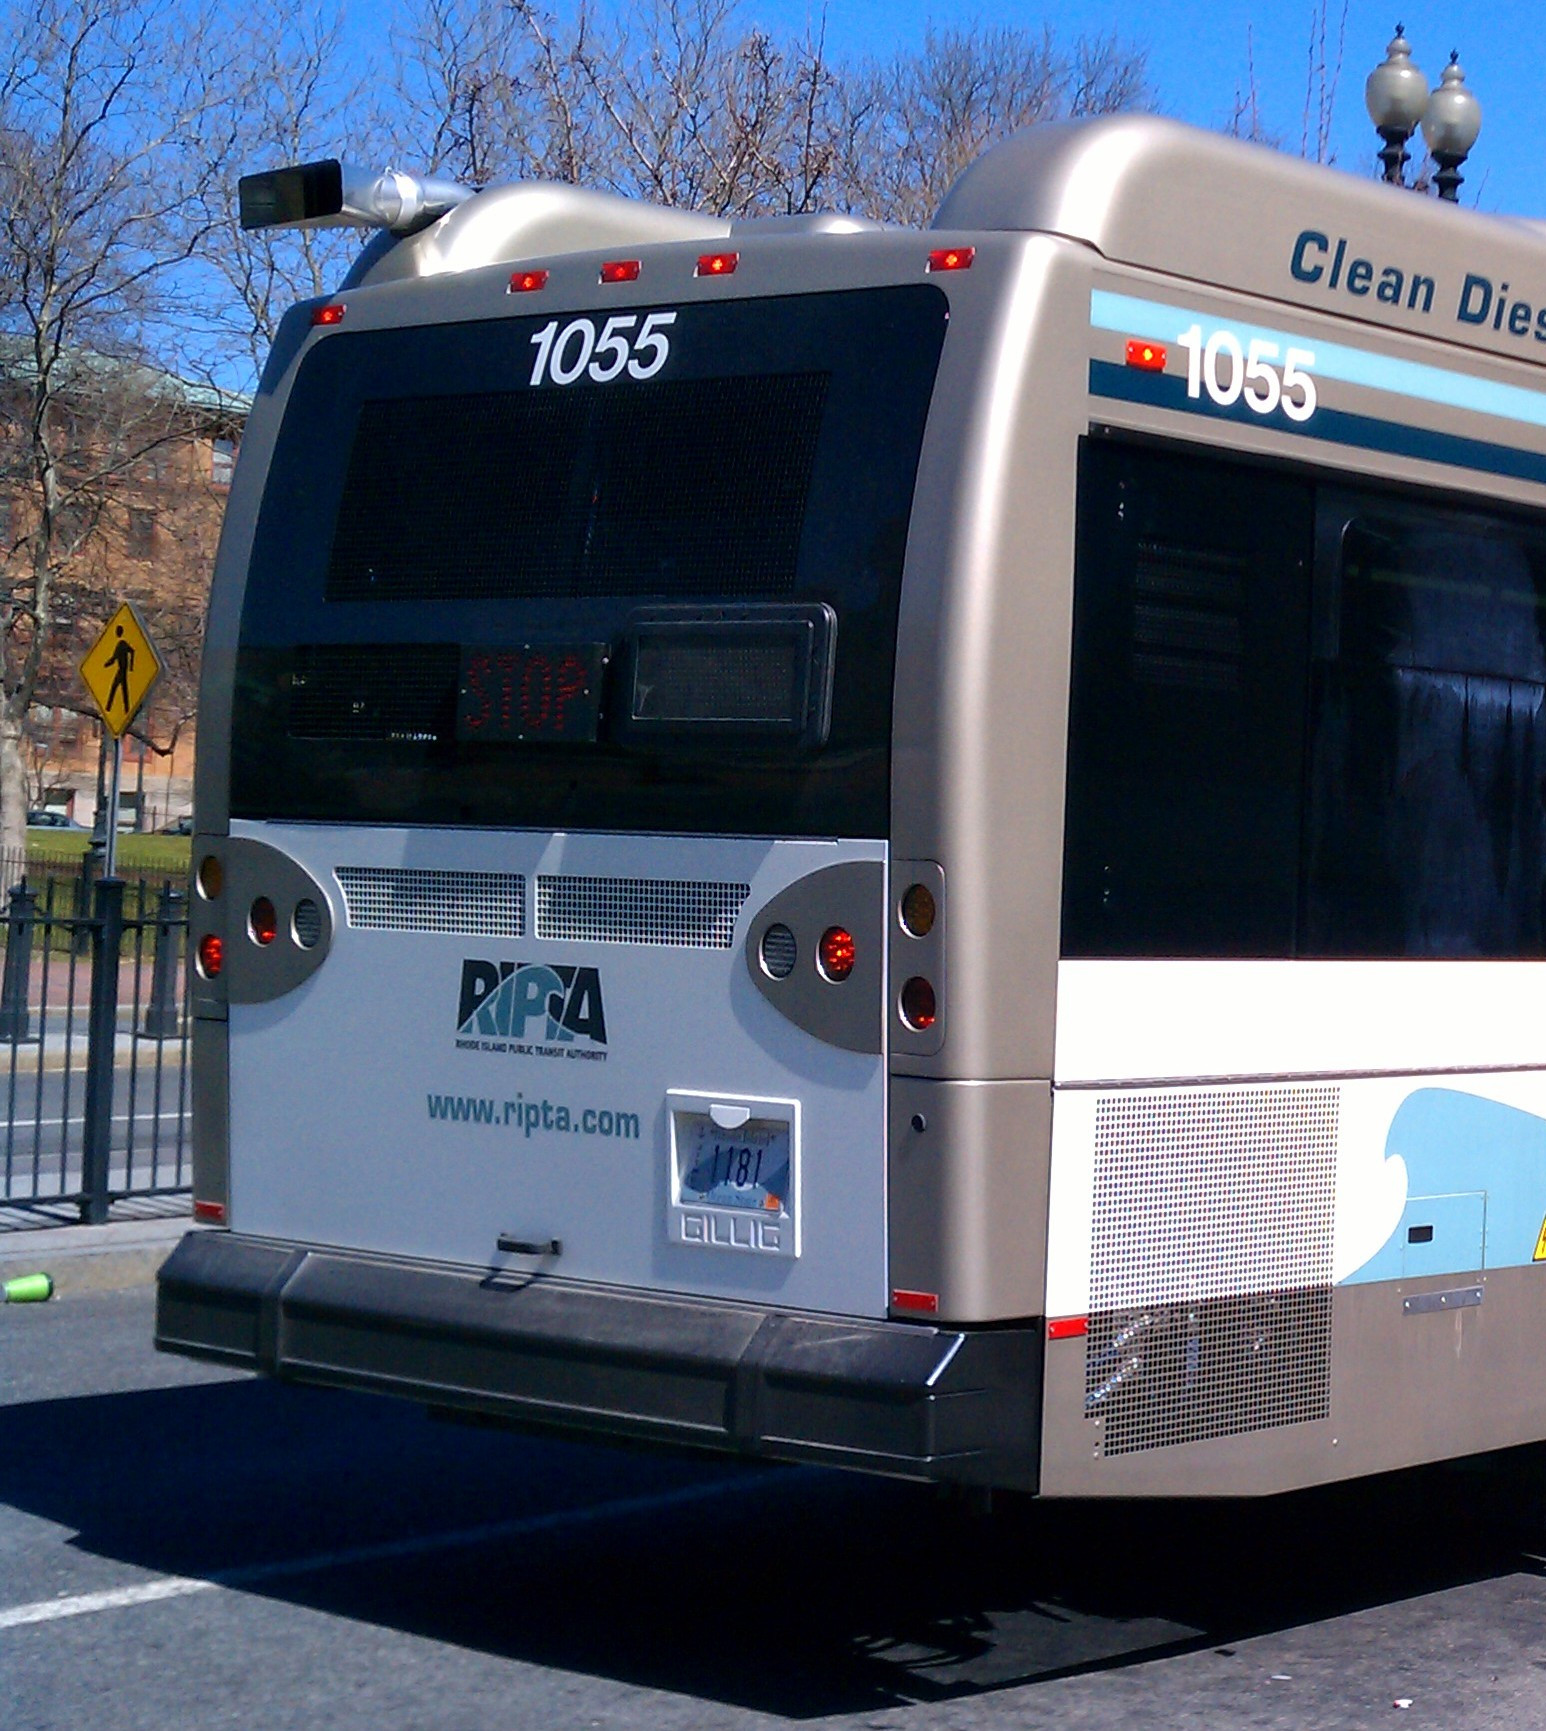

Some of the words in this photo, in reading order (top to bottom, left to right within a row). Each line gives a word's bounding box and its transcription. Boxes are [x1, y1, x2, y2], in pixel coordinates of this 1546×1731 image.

[1289, 230, 1436, 313] Clean
[530, 312, 677, 386] 1055
[1177, 324, 1317, 422] 1055
[466, 654, 587, 731] STOP
[457, 958, 608, 1044] RIPTA
[427, 1092, 640, 1139] www.ripta.com
[711, 1144, 763, 1189] 1181
[681, 1215, 780, 1251] GILLIG
